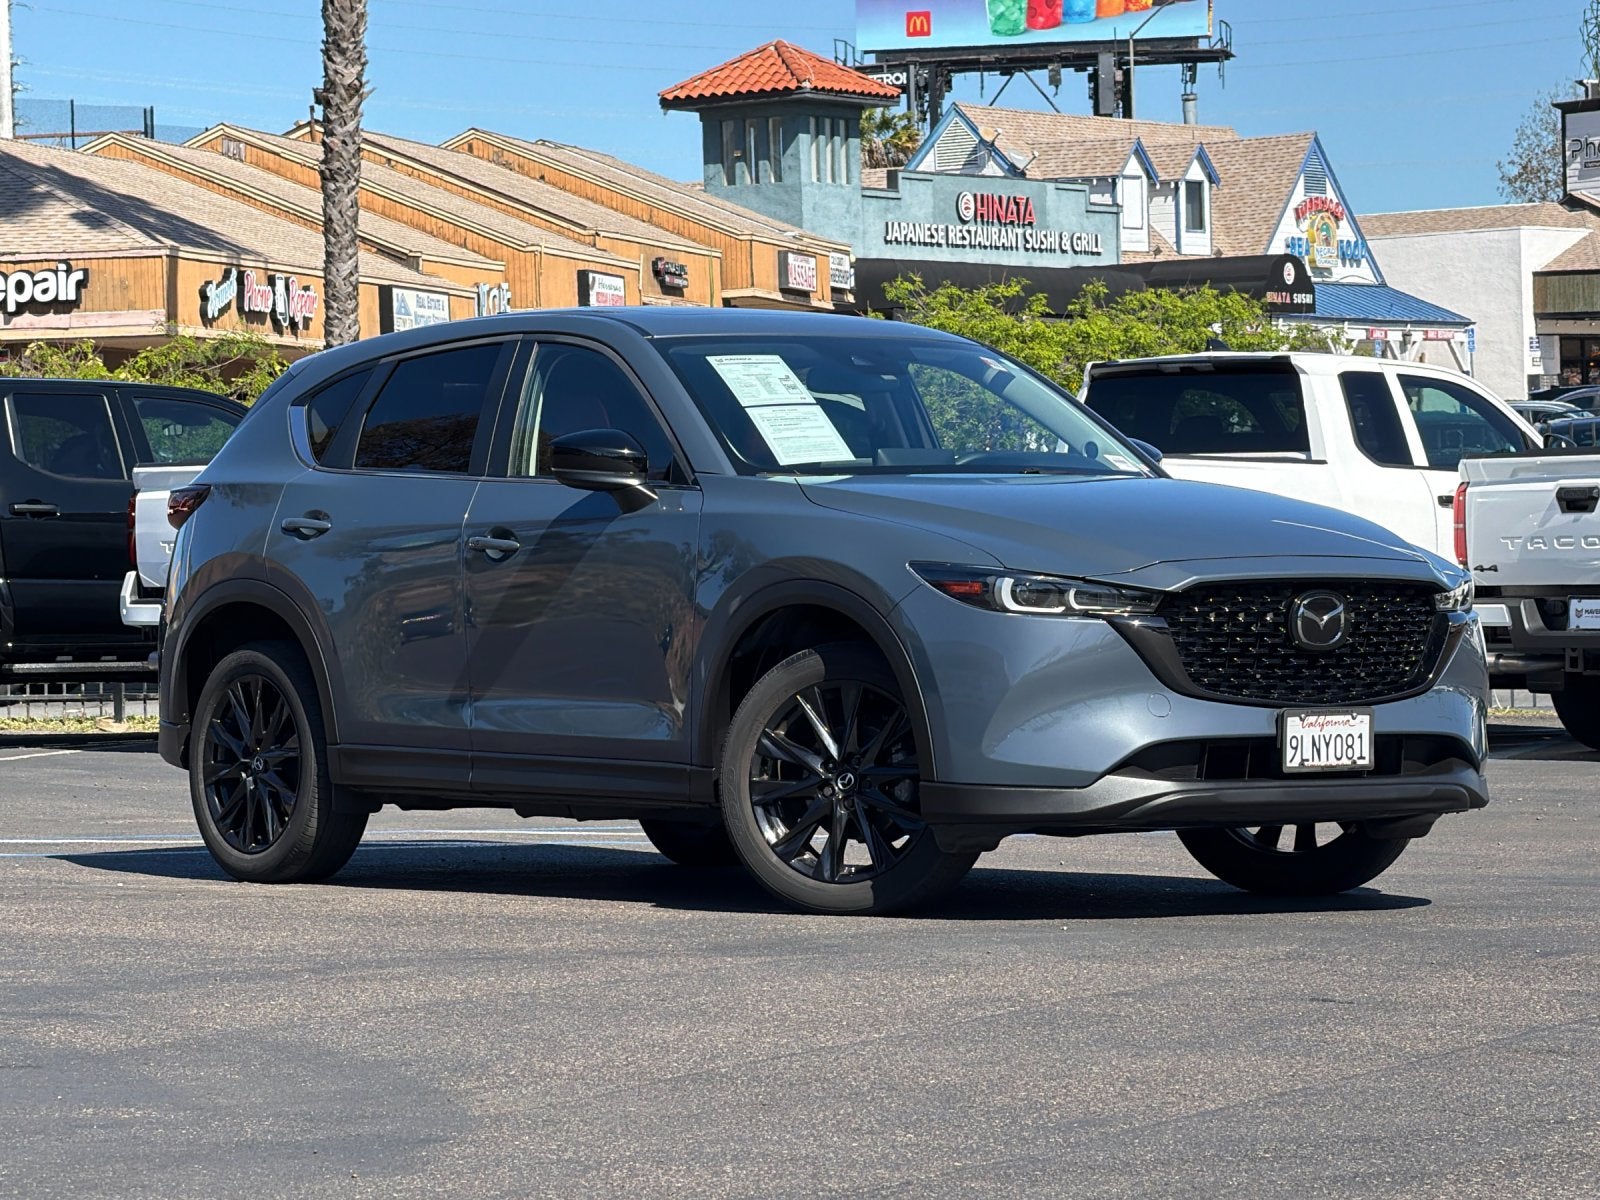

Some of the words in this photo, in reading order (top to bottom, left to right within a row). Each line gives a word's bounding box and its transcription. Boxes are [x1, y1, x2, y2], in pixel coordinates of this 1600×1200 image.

[976, 192, 1036, 225] HINATA
[886, 221, 946, 244] JAPANESE
[947, 225, 1023, 248] RESTAURANT
[1025, 229, 1059, 250] SUSHI
[1061, 231, 1071, 251] &
[1073, 232, 1104, 253] GRILL
[1339, 239, 1367, 260] FOOD
[787, 262, 816, 290] MASSAGE
[243, 269, 274, 313] Phone
[288, 275, 319, 331] Repair
[1293, 292, 1313, 304] SUSHI
[1301, 716, 1356, 732] California
[1289, 733, 1366, 763] 9LNY081
